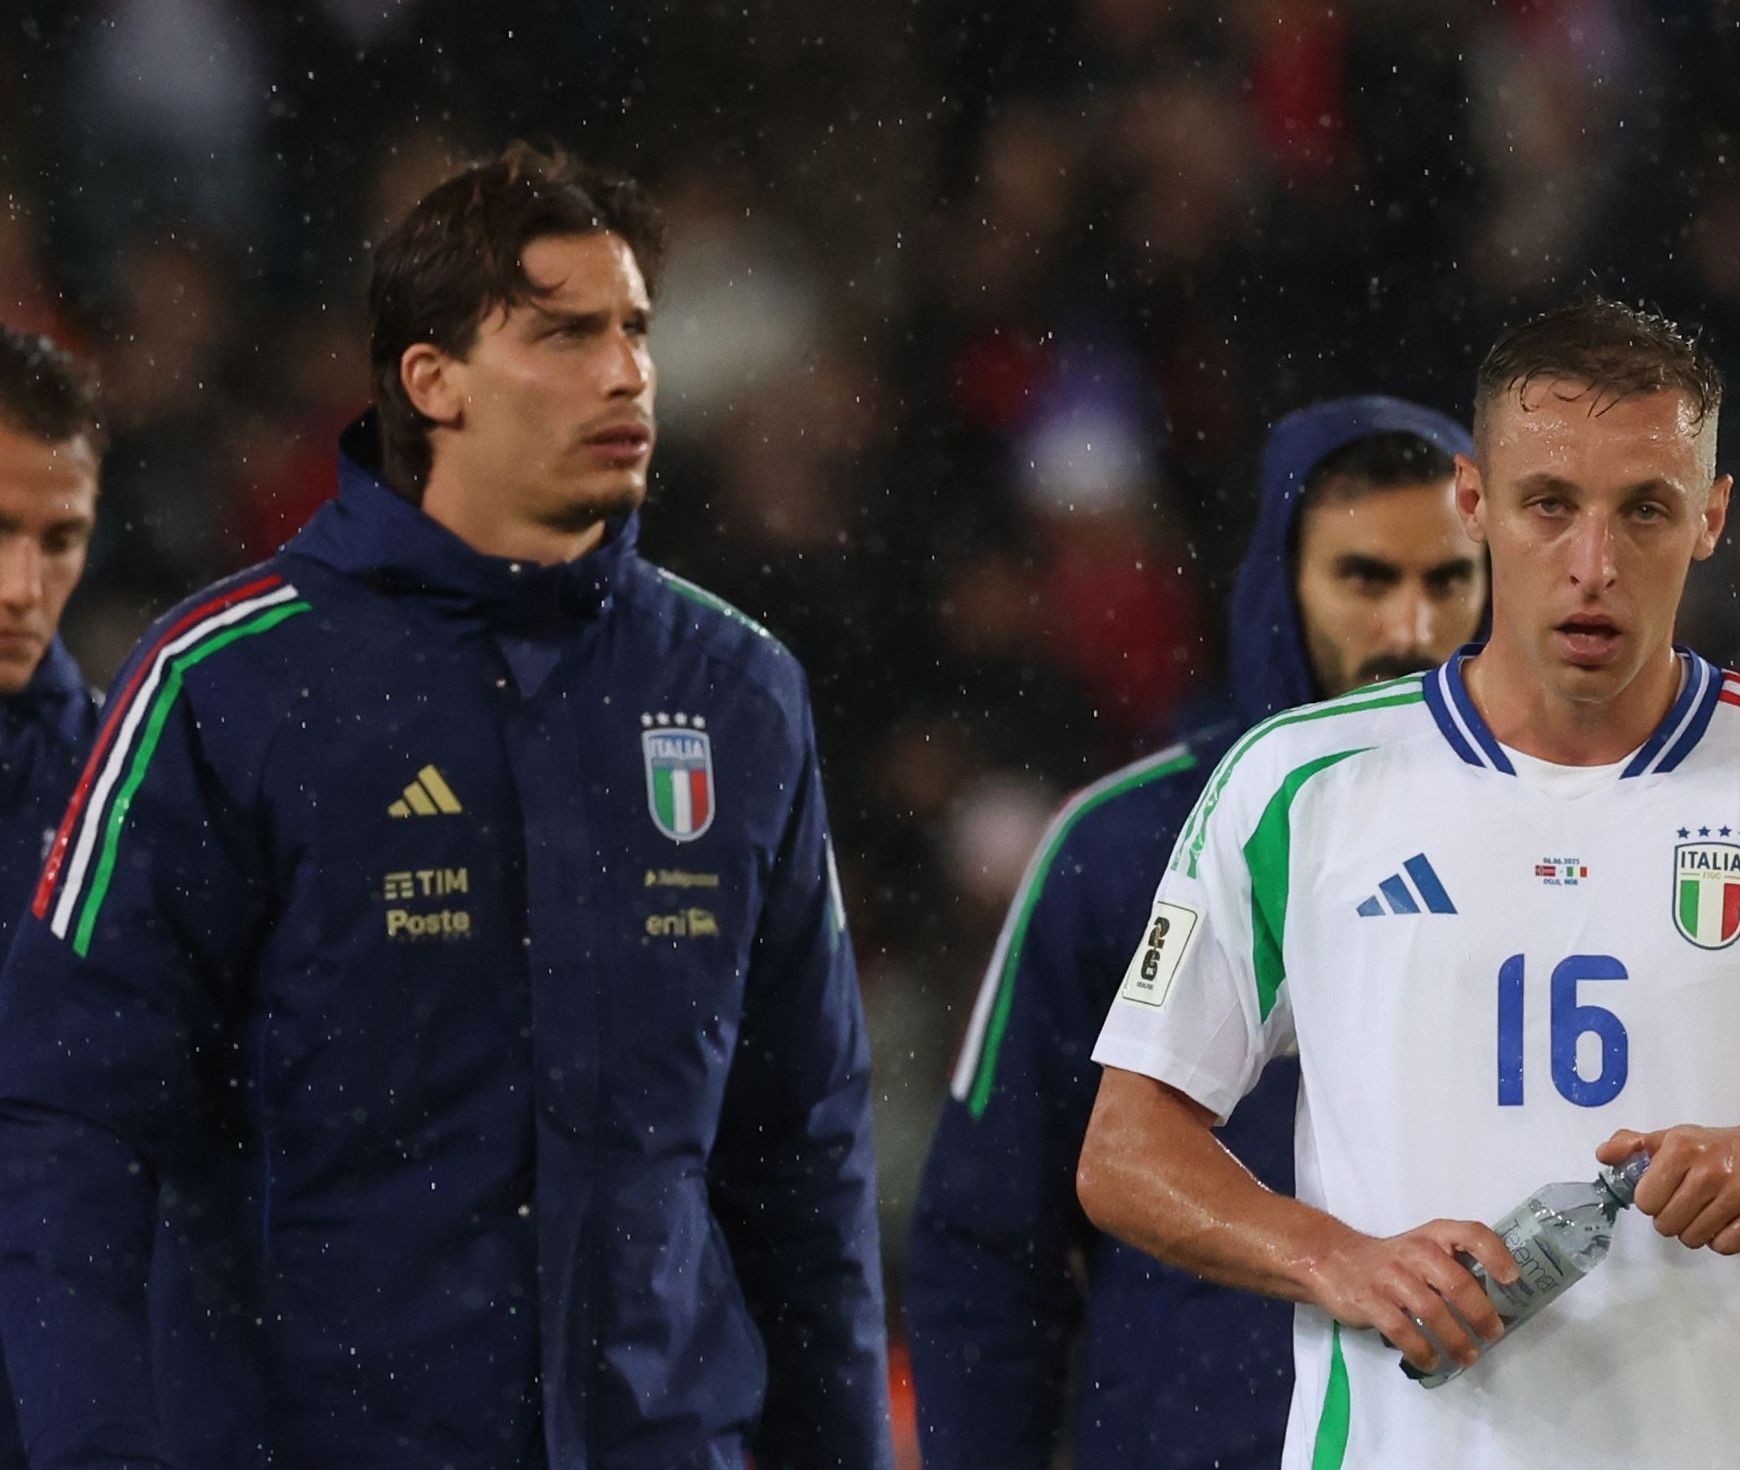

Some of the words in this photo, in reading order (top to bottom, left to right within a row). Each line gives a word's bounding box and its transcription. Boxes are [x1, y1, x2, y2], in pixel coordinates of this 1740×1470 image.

[653, 738, 705, 758] ITALIA
[416, 867, 469, 896] TIM
[387, 909, 470, 936] Poste
[645, 911, 686, 936] eni
[1497, 952, 1630, 1108] 16
